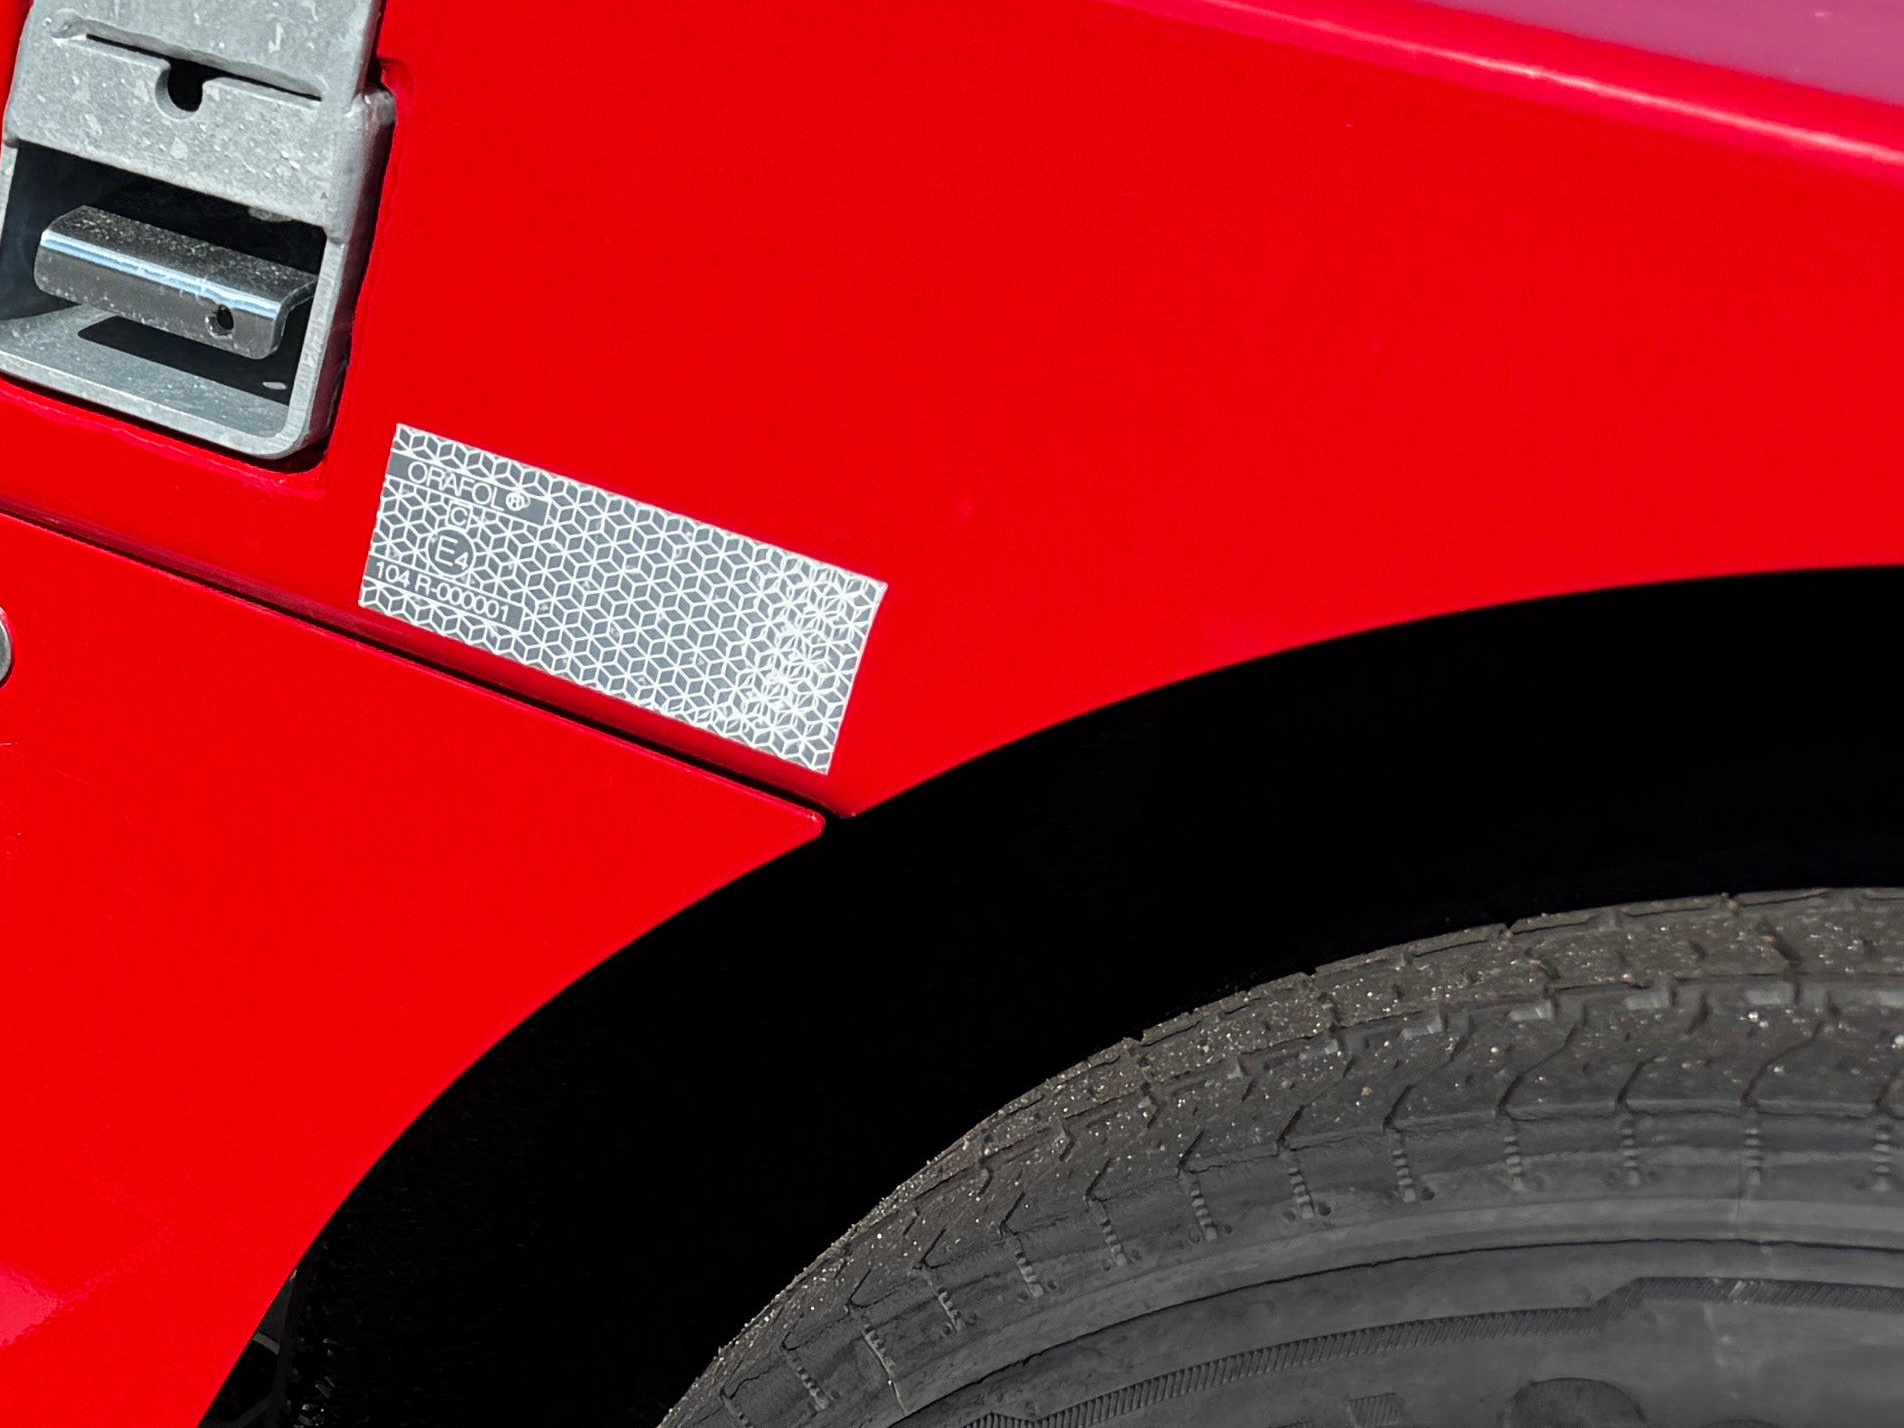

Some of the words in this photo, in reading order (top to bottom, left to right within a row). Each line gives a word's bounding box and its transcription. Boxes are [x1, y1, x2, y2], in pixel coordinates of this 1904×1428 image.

[435, 534, 470, 571] E4
[375, 561, 410, 588] 104
[414, 573, 510, 623] R-000001
